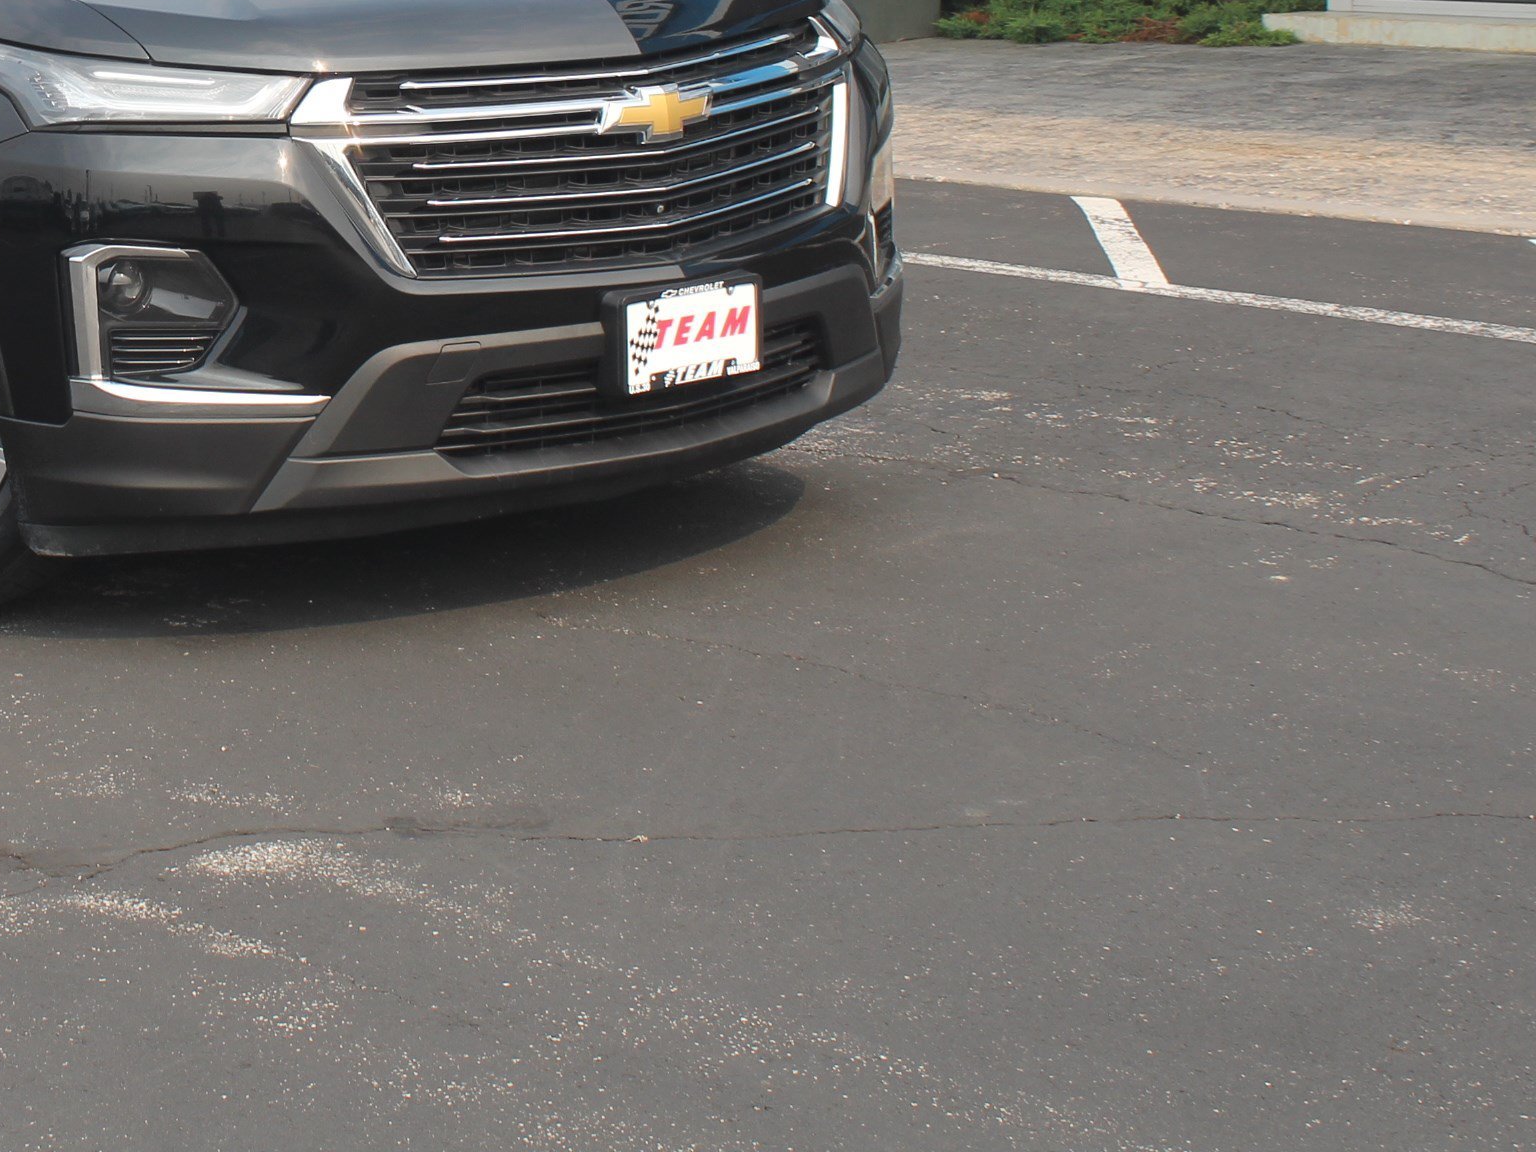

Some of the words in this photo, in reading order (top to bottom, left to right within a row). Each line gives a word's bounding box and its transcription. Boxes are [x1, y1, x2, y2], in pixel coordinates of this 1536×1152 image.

[678, 280, 724, 296] CHEVROLET
[654, 305, 751, 350] TEAM
[675, 359, 725, 383] TEAM
